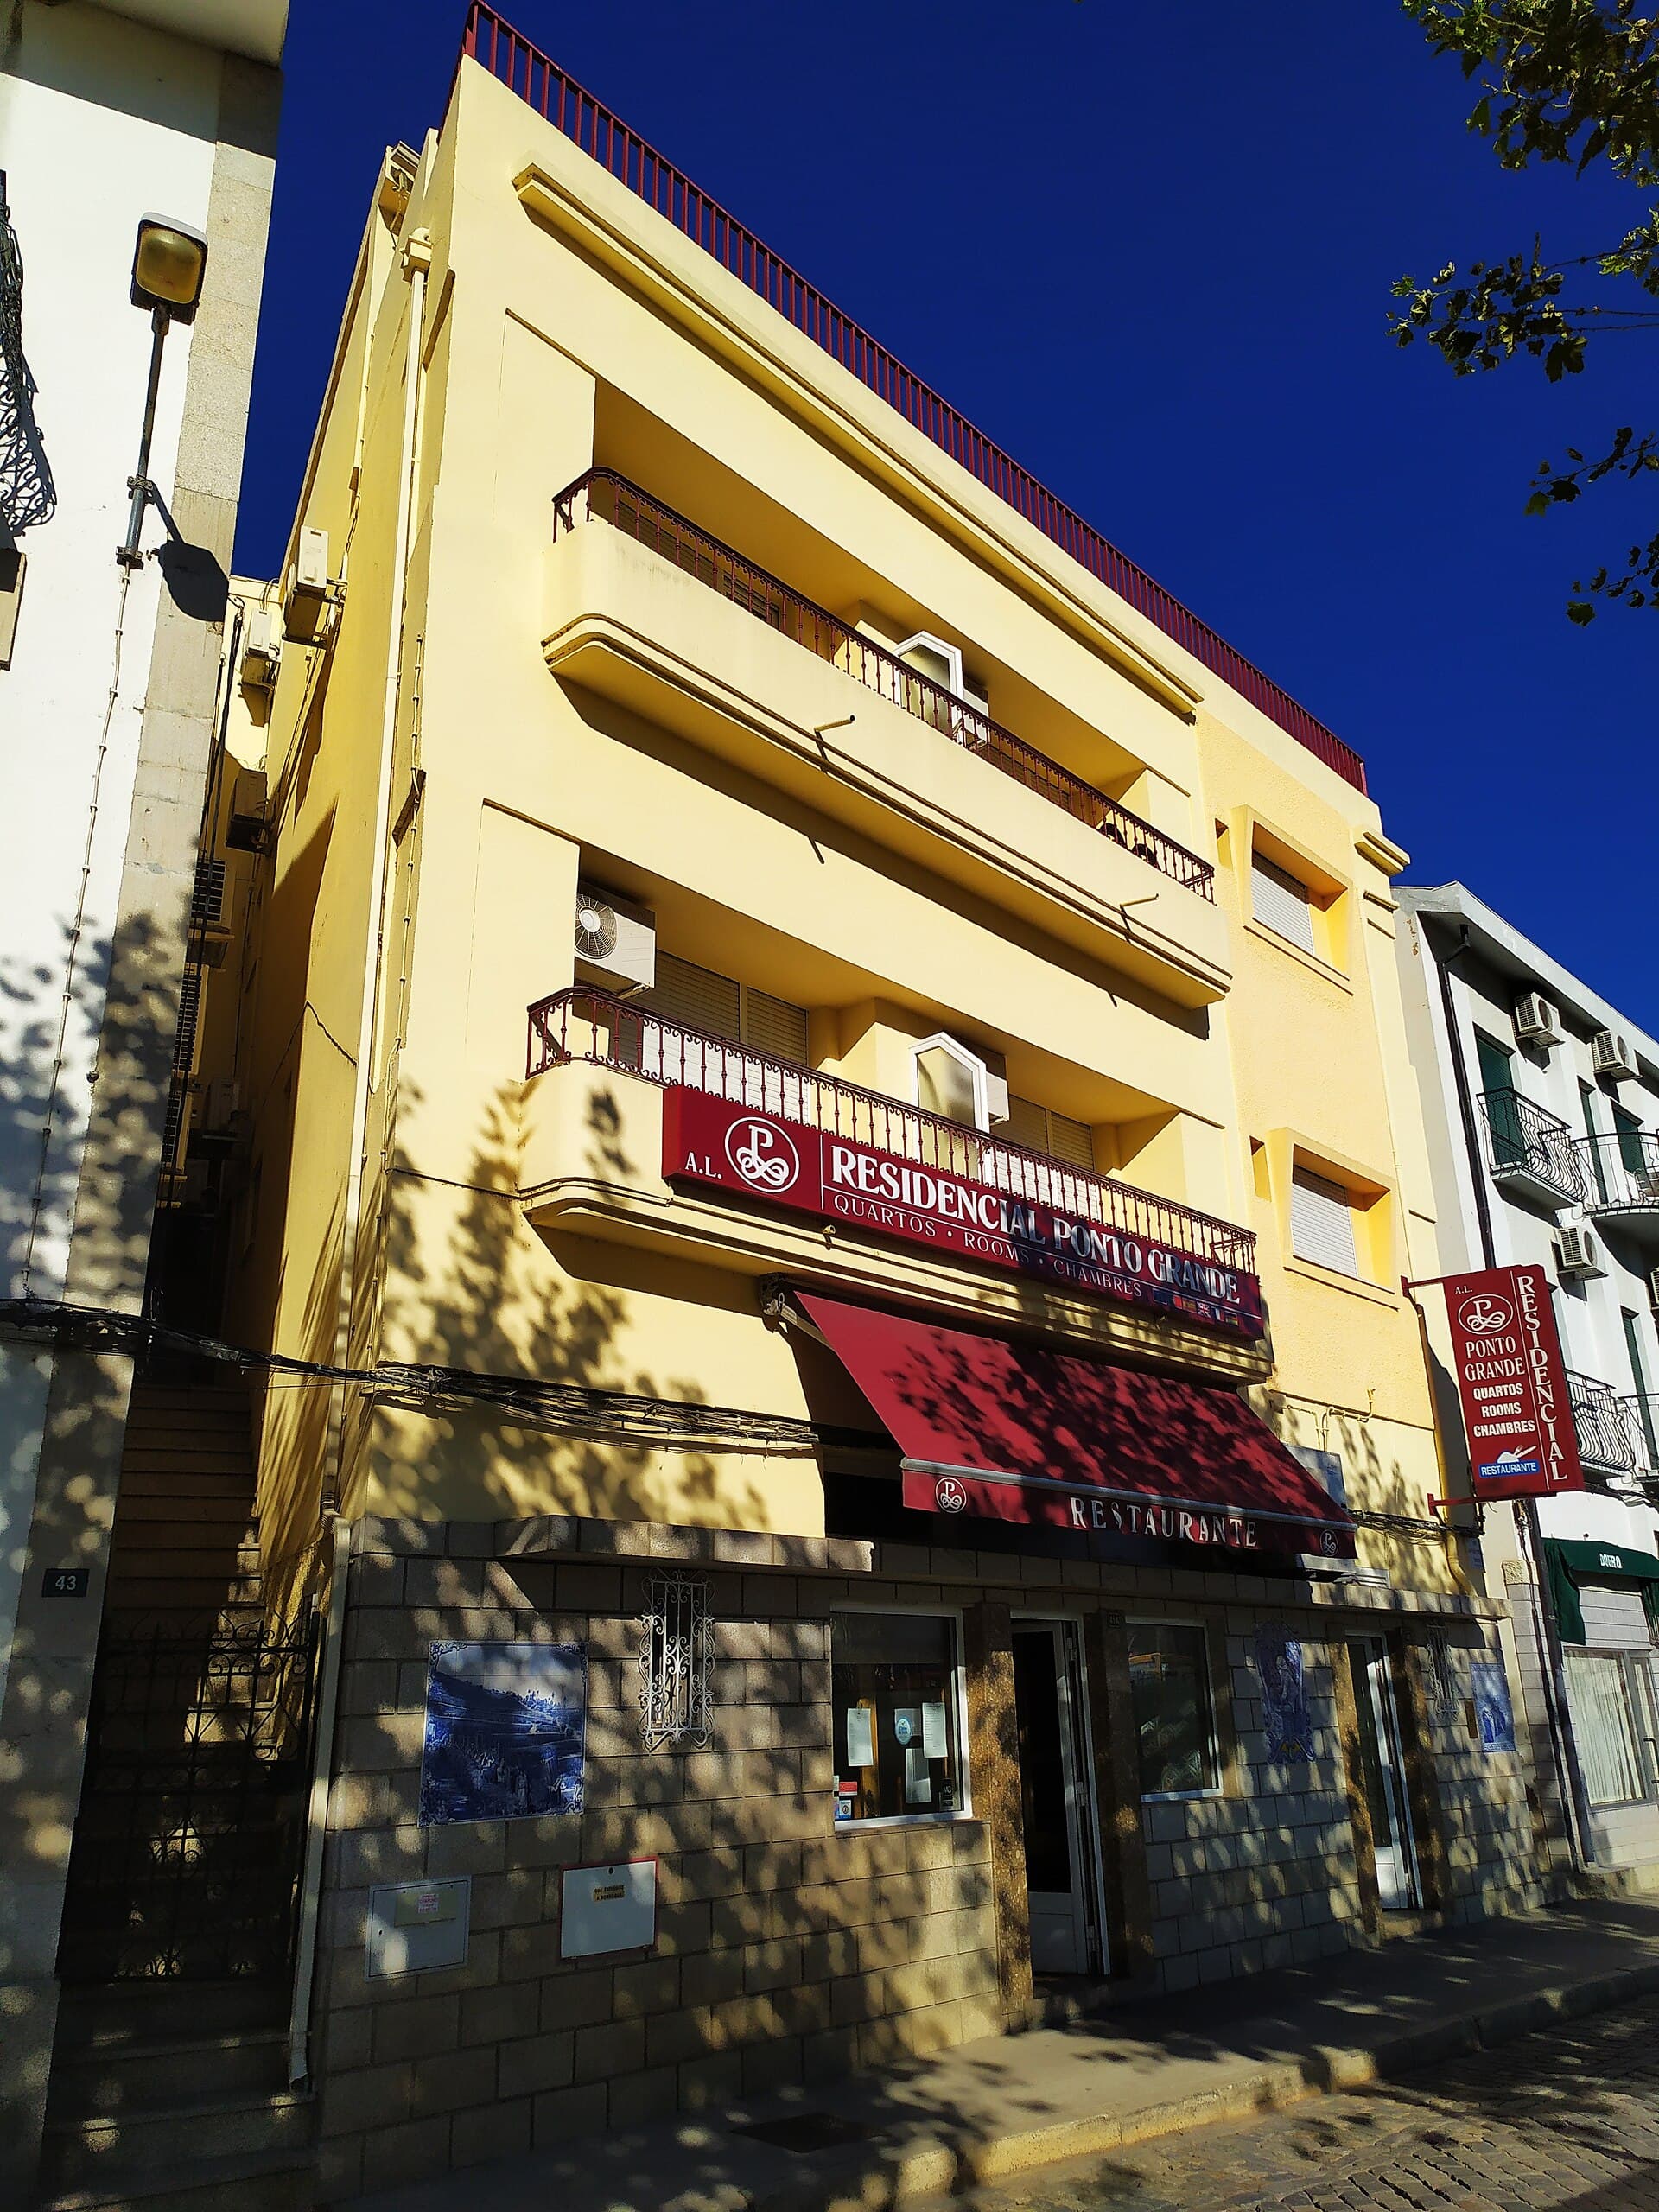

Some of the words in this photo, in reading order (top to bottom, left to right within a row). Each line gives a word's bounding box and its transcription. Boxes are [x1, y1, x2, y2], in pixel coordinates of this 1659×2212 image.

[685, 1152, 722, 1179] A.L.
[831, 1146, 1046, 1245] RESIDENCIAL
[1053, 1217, 1142, 1273] PONTO
[1147, 1249, 1241, 1304] GRANDE
[834, 1194, 936, 1237] QUARTOS
[964, 1231, 1030, 1265] ROOMS
[1053, 1259, 1142, 1297] CHAMBRES
[1454, 1285, 1473, 1294] A.L.
[1465, 1335, 1516, 1359] PONTO
[1465, 1357, 1525, 1382] GRANDE
[1516, 1275, 1568, 1481] RESIDENCIAL
[1473, 1382, 1523, 1401] QUARTOS
[1481, 1402, 1522, 1418] ROOMS
[1473, 1420, 1536, 1438] CHAMBRES
[1481, 1462, 1537, 1476] RESTAURANTE
[1070, 1497, 1257, 1548] RESTAURANTE
[54, 1575, 77, 1591] 43
